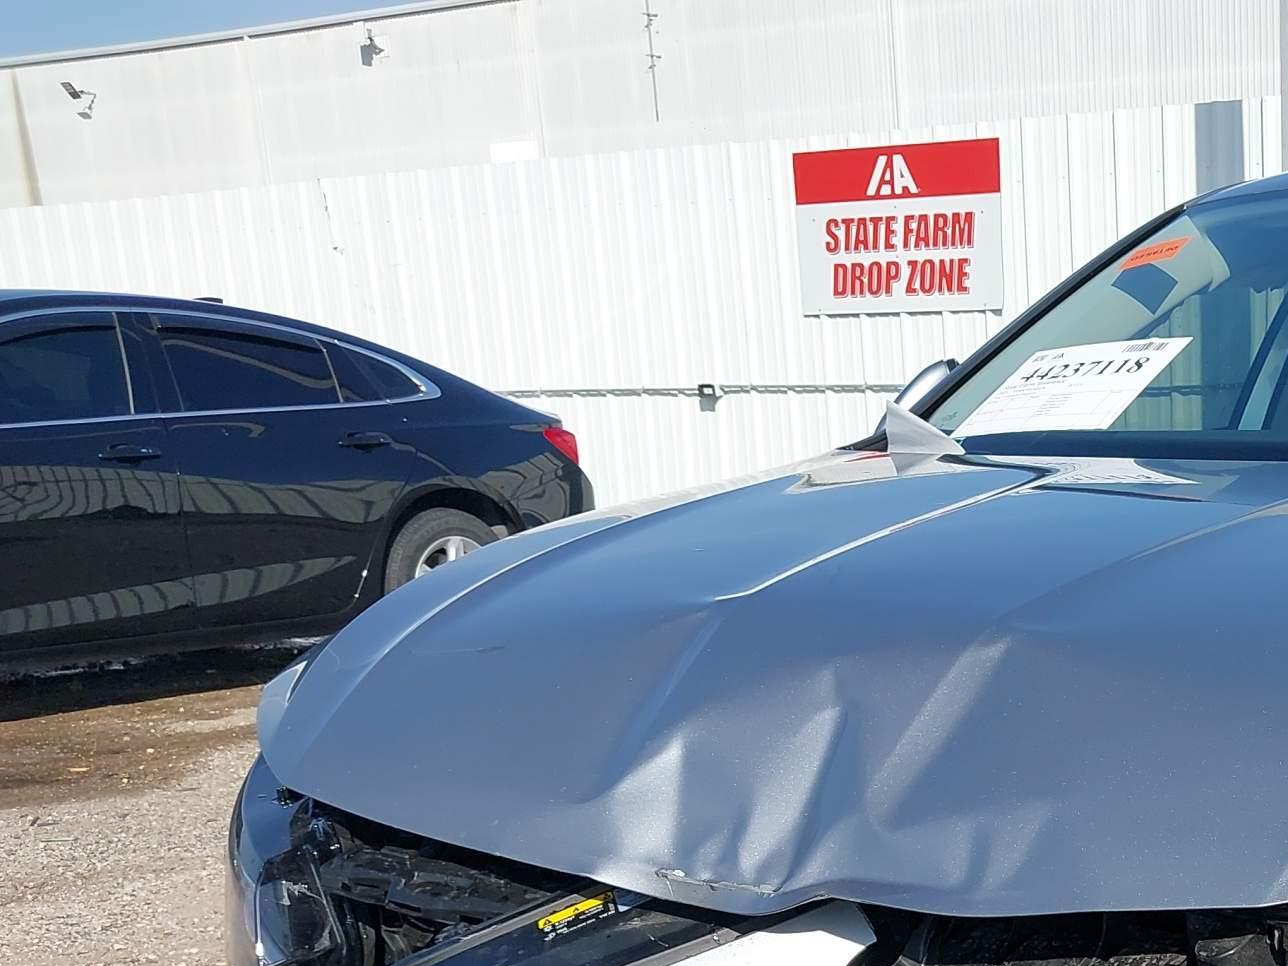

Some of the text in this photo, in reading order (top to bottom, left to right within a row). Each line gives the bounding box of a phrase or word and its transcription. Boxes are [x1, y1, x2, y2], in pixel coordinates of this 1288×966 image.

[825, 211, 975, 255] STATE FARM
[832, 257, 971, 298] DROP ZONE
[1020, 356, 1151, 382] 44237118
